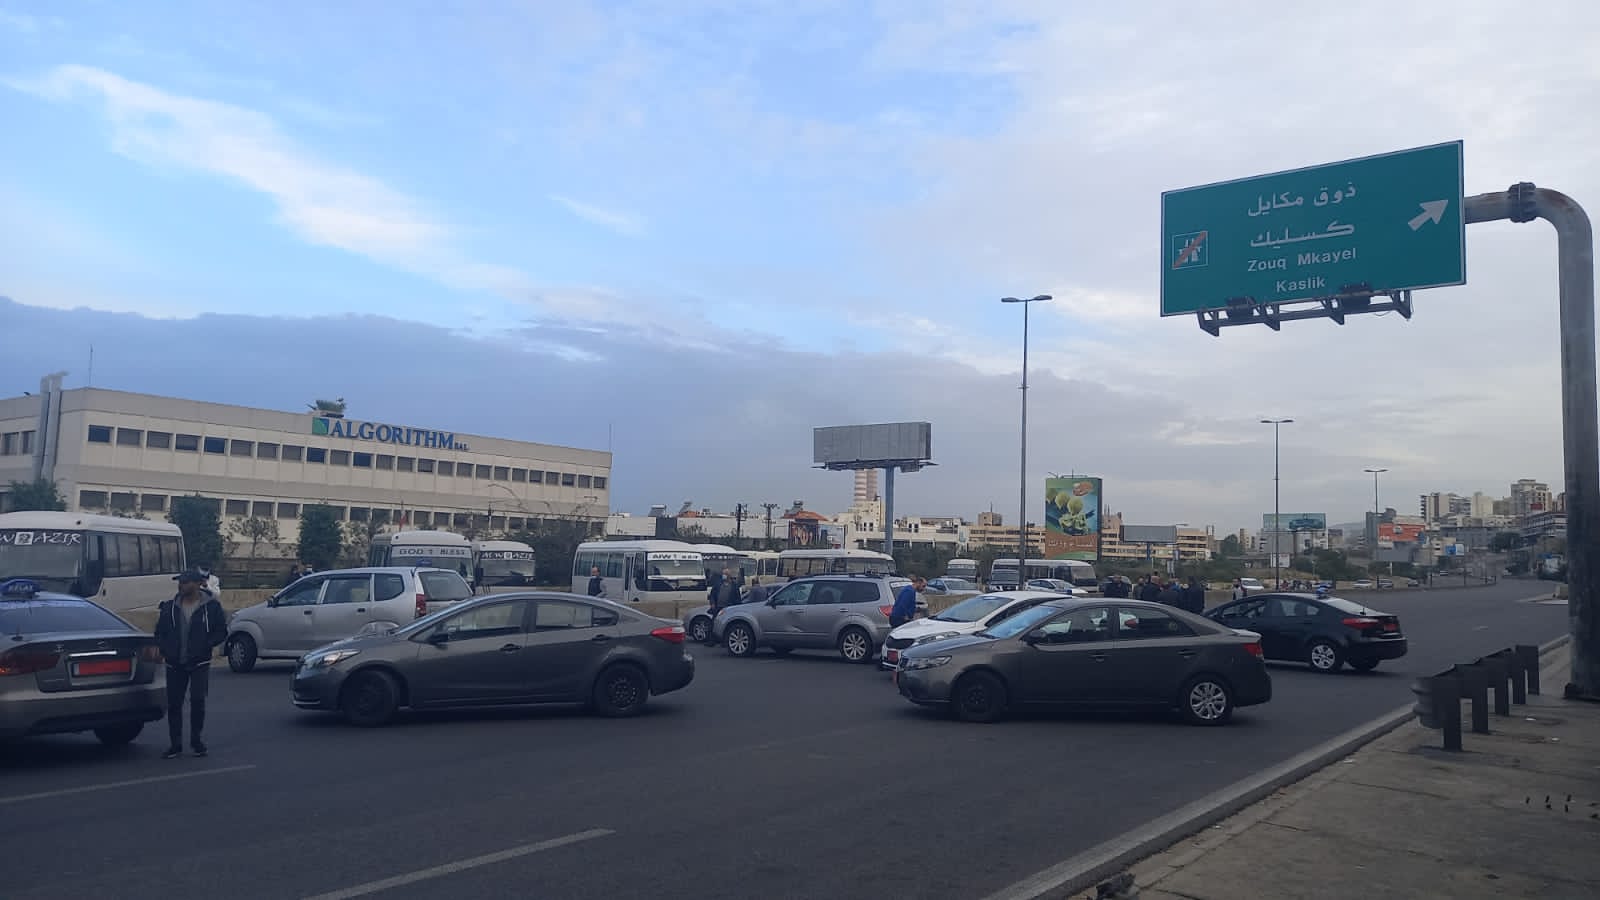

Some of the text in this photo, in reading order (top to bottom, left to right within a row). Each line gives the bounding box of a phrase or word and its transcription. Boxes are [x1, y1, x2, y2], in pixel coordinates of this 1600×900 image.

[1247, 181, 1357, 217] ذوق مكايل
[1250, 220, 1355, 249] كسليك
[1247, 247, 1357, 273] Zouq Mkayel
[1275, 276, 1326, 293] Kaslik
[331, 420, 454, 450] ALGORITHM
